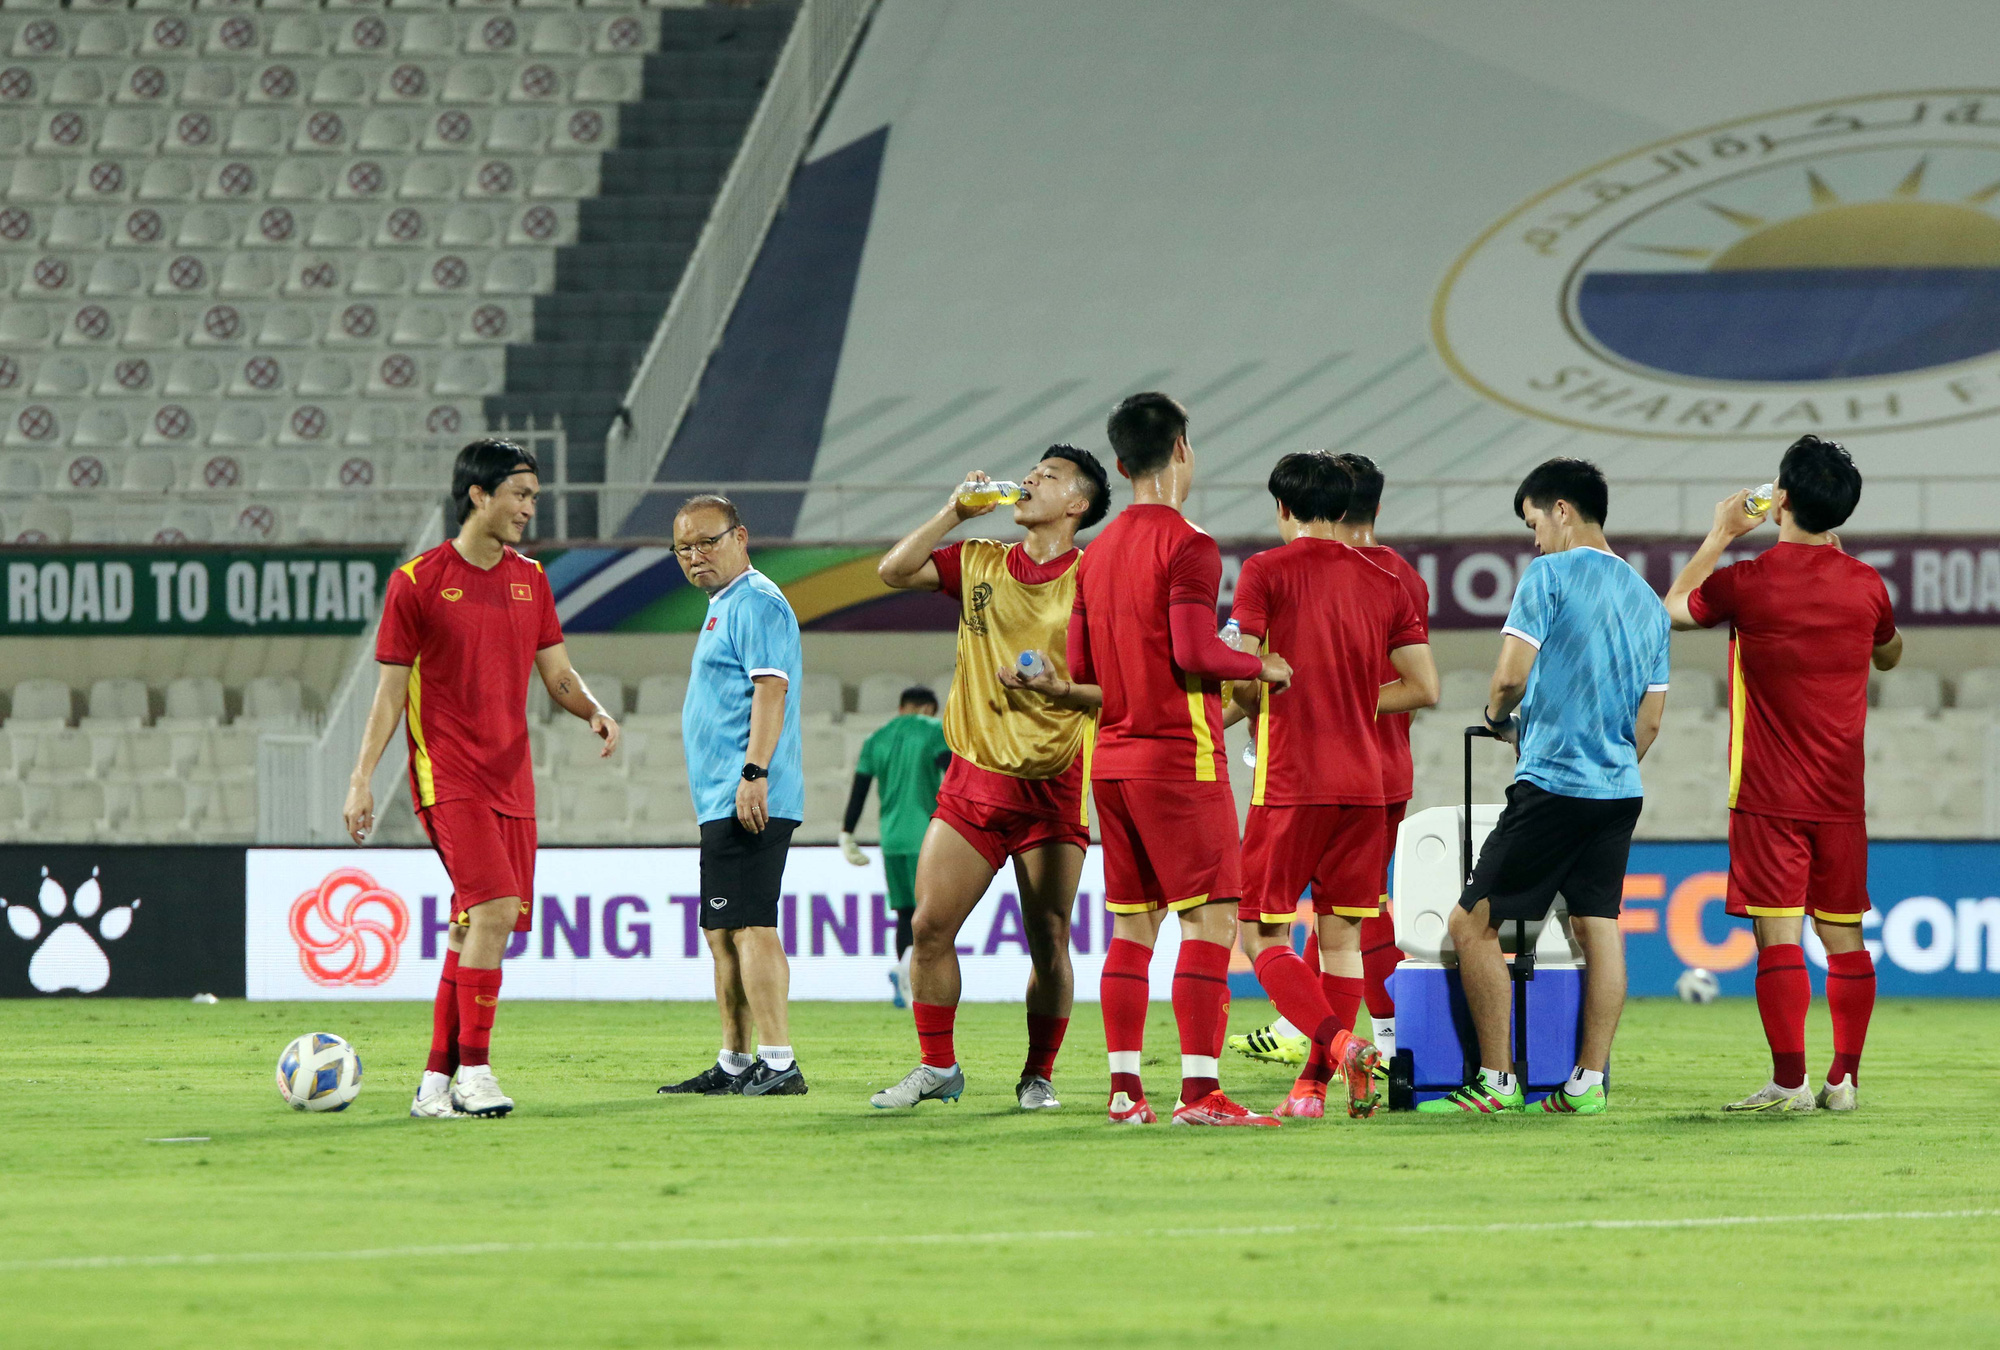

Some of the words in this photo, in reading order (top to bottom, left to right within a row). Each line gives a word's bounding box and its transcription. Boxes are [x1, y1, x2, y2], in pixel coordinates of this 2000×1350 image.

[1527, 364, 1900, 431] SHARJAH
[8, 561, 134, 623] ROAD
[150, 561, 209, 623] TO
[226, 560, 377, 626] QATAR
[420, 895, 652, 960] HNG
[668, 894, 900, 957] TINH
